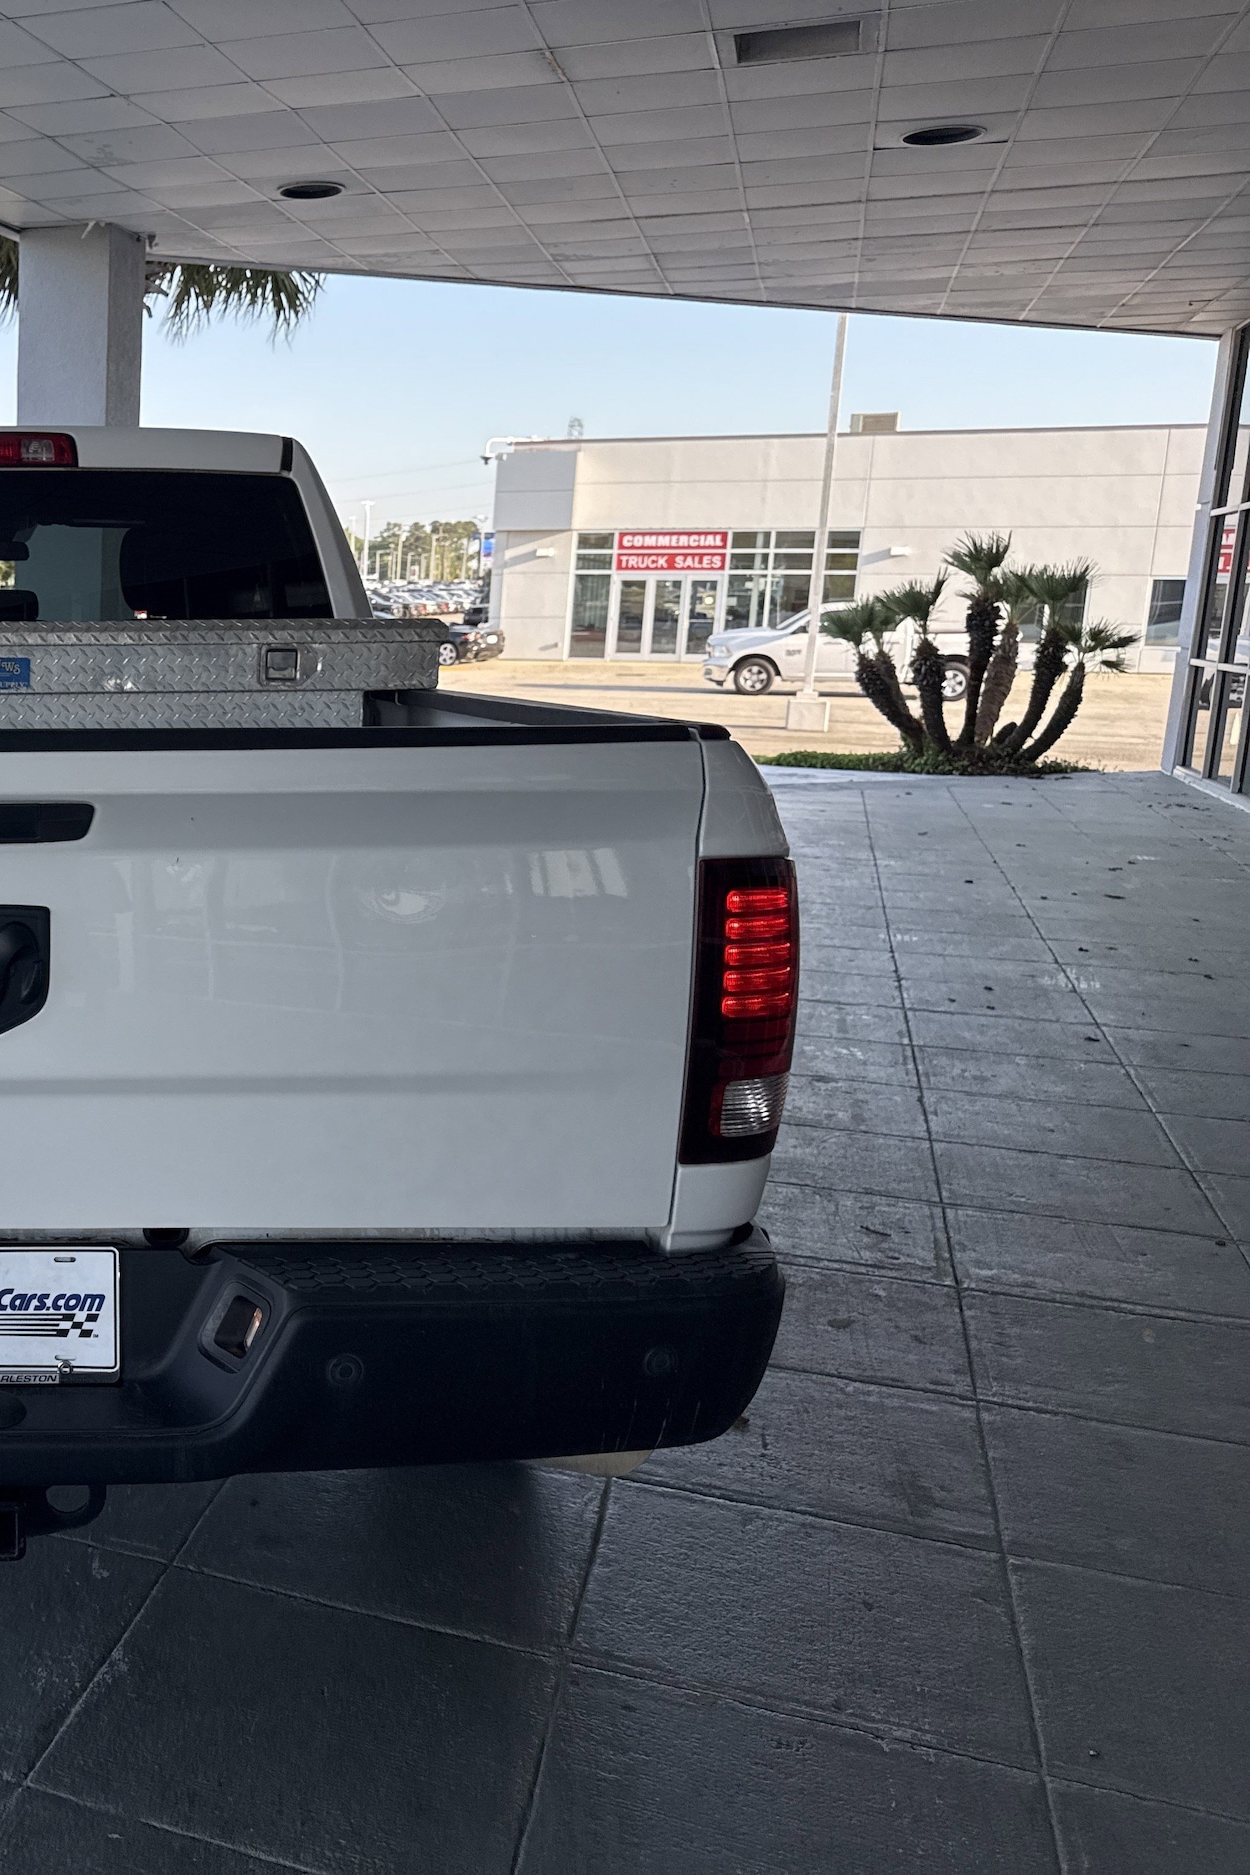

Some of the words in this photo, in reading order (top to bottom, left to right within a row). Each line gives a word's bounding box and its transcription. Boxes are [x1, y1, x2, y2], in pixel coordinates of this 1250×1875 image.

[622, 534, 723, 547] COMMERCIAL
[620, 555, 668, 568] TRUCK
[674, 555, 721, 568] SALES
